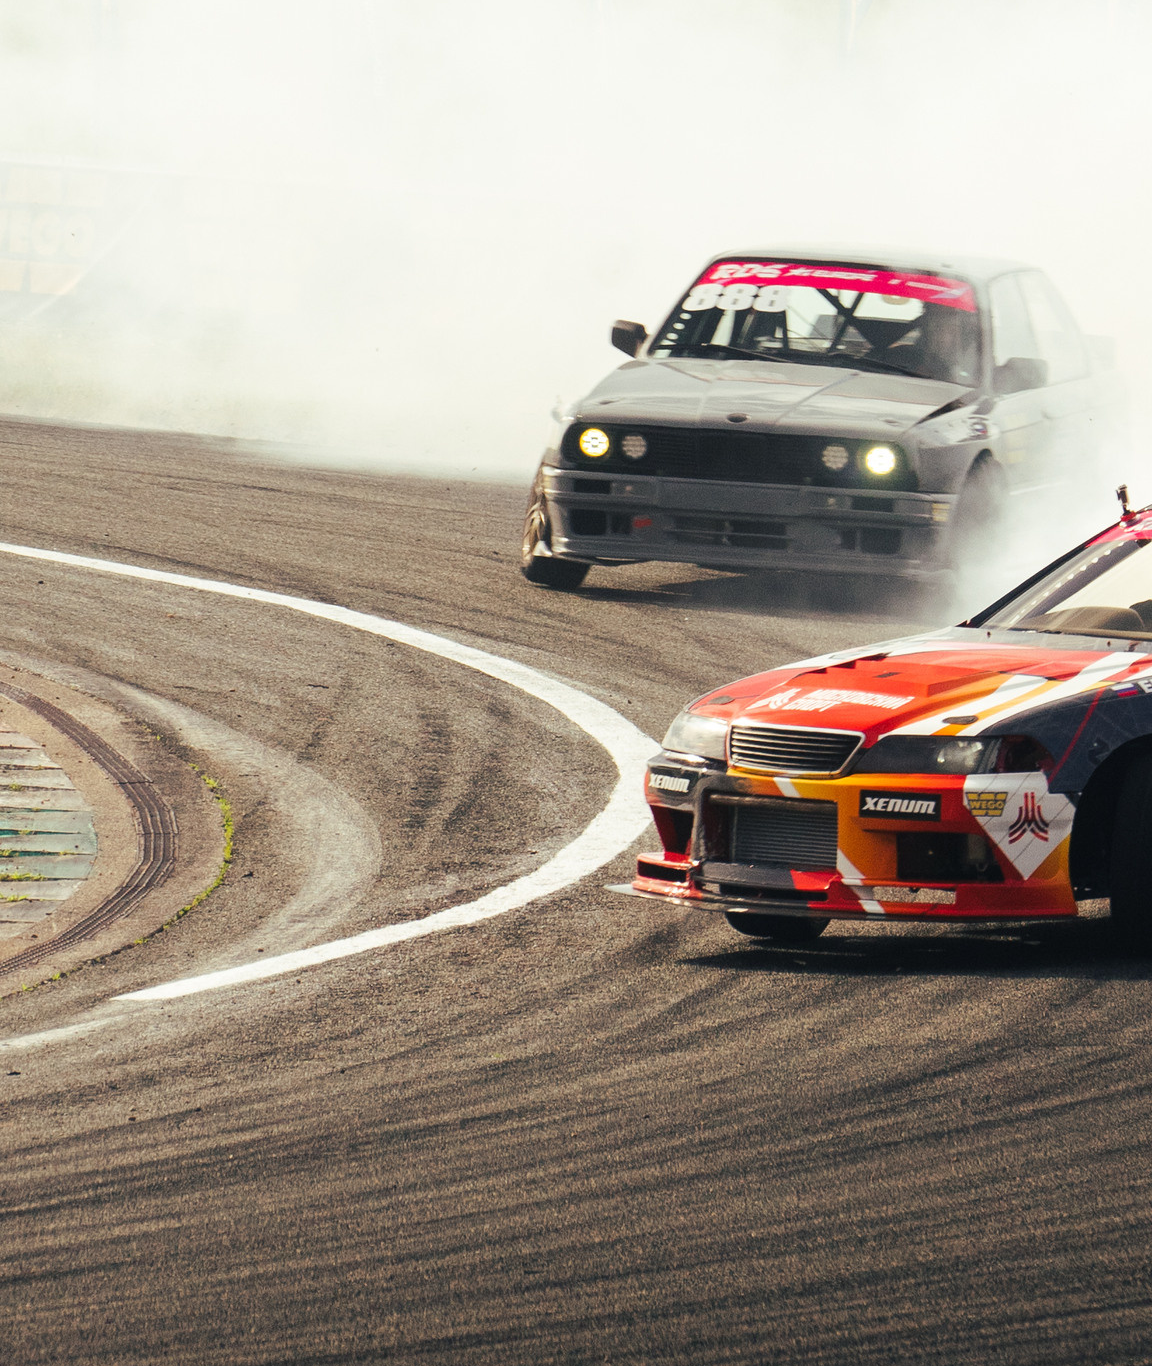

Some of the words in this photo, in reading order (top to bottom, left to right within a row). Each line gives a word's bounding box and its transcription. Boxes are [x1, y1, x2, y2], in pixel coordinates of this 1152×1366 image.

[682, 283, 790, 313] 888
[861, 797, 936, 815] XENUM
[969, 800, 1005, 810] WEGO
